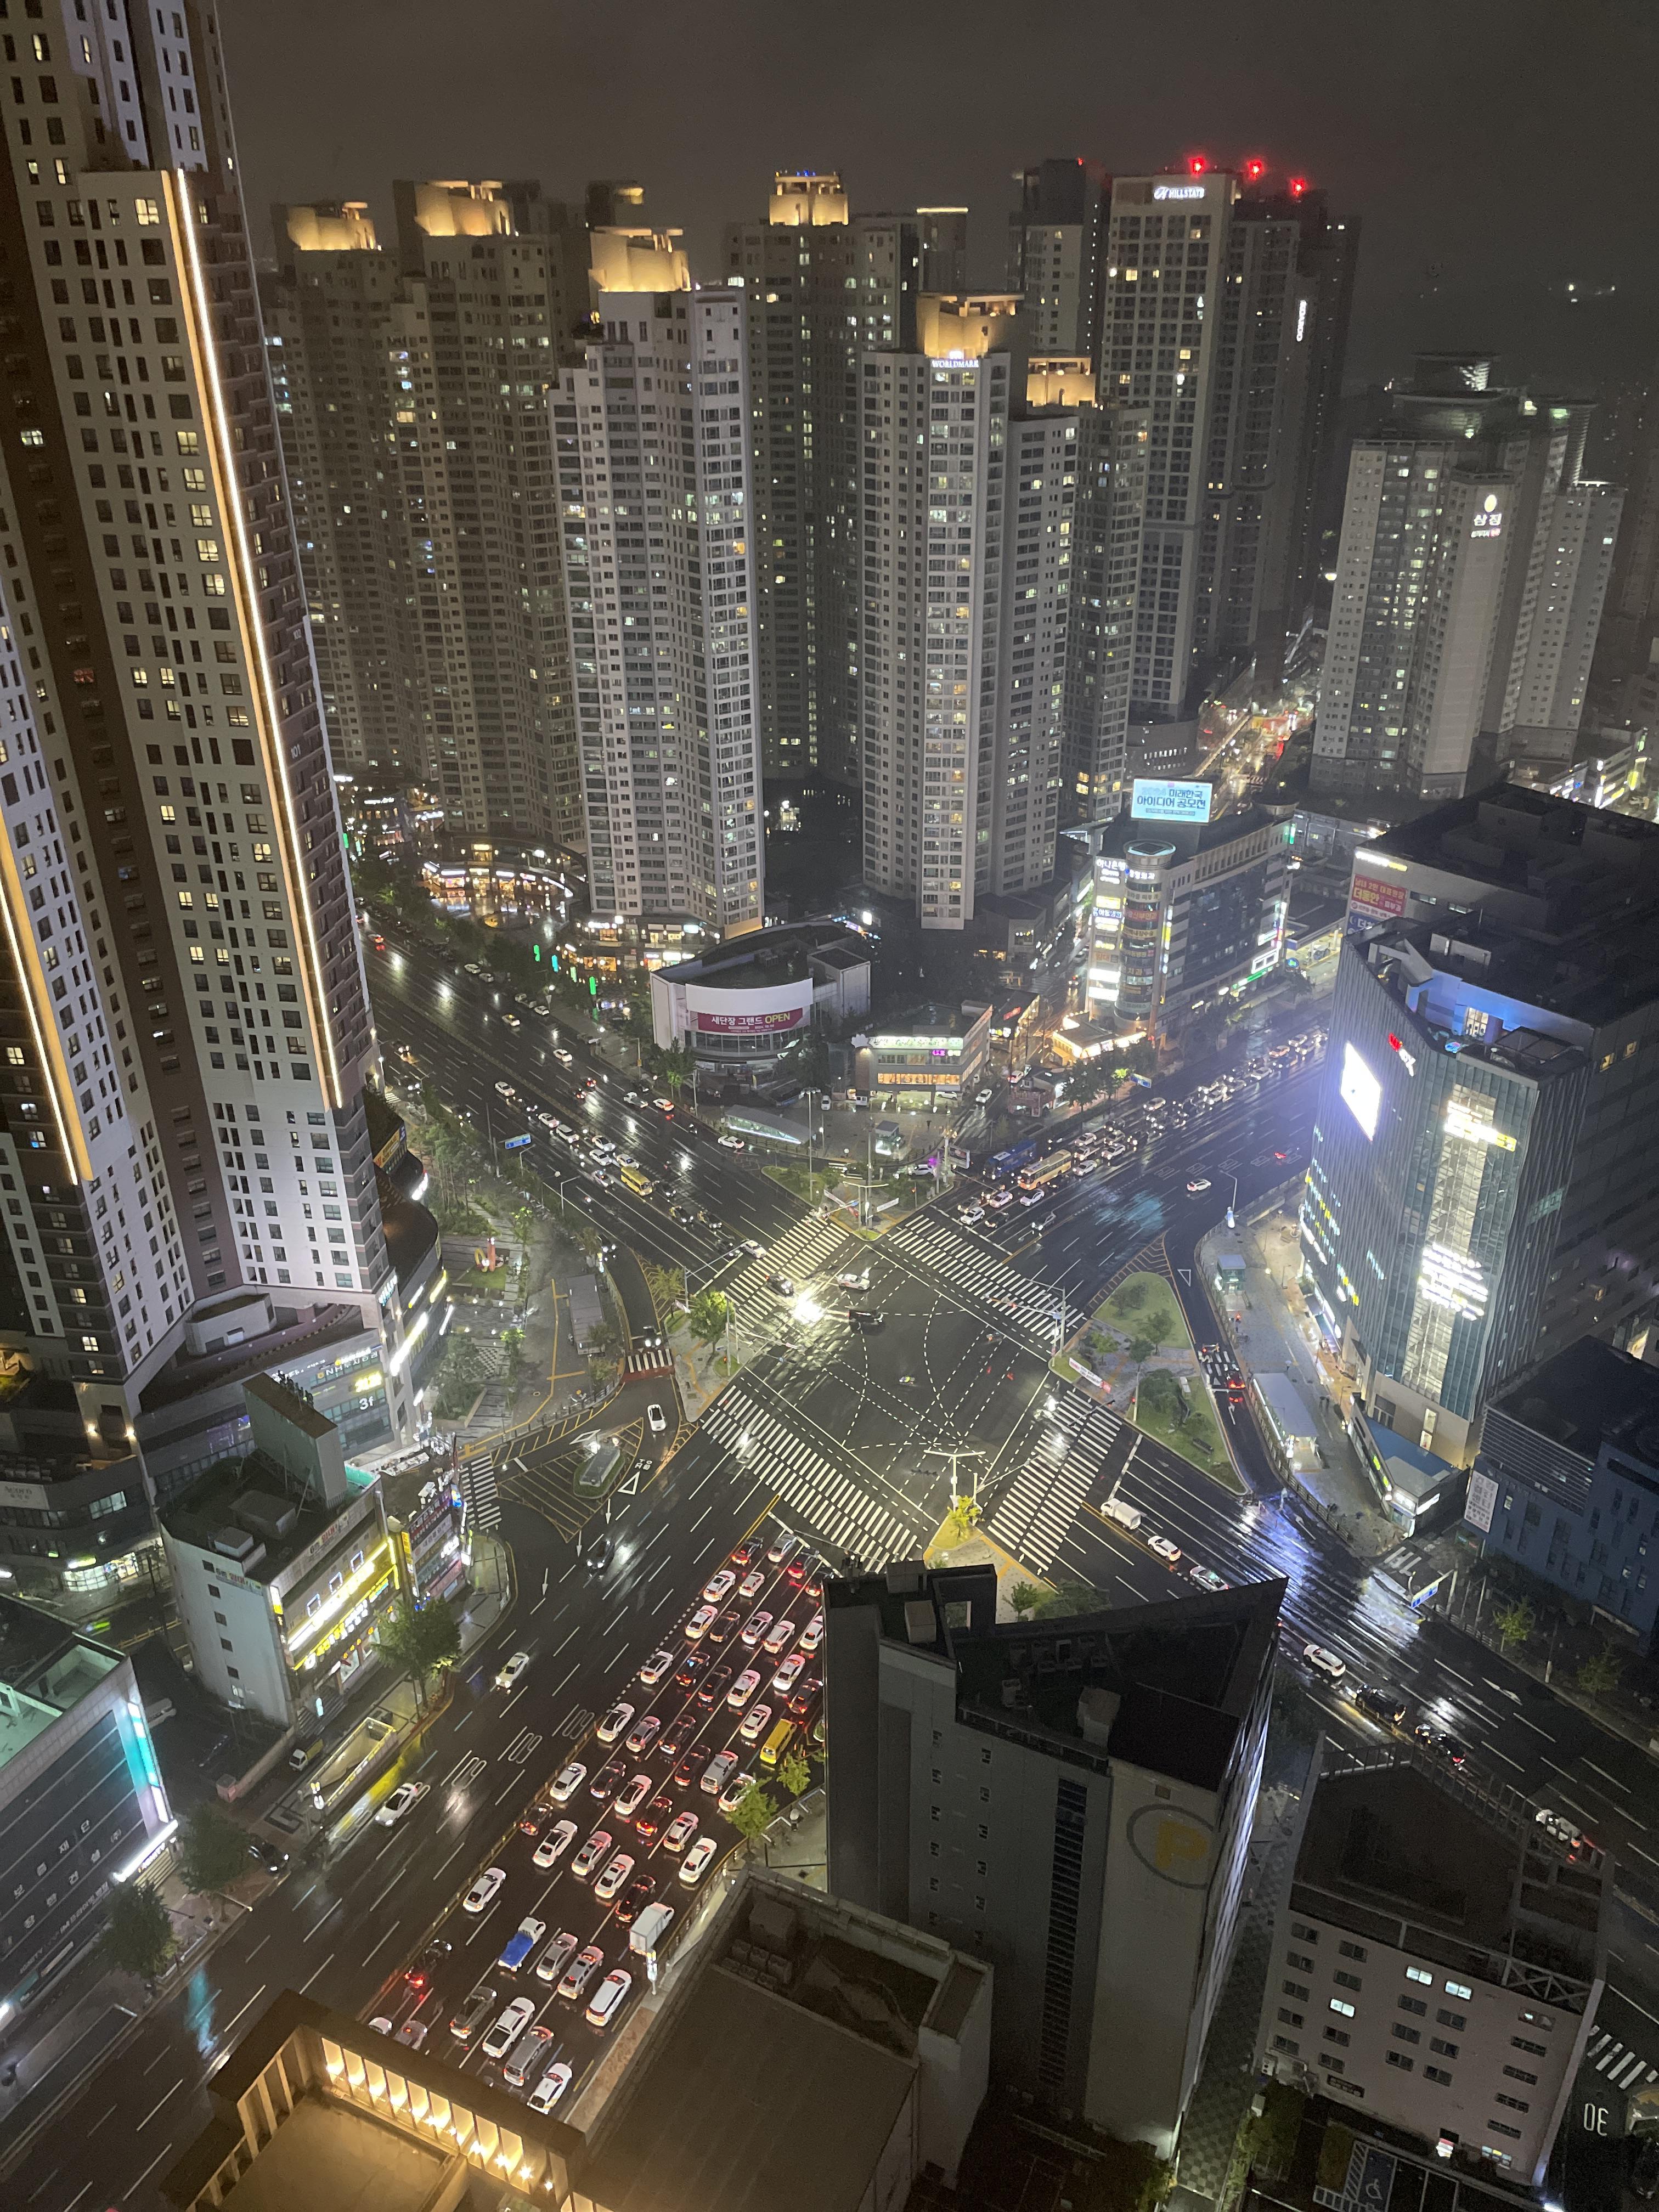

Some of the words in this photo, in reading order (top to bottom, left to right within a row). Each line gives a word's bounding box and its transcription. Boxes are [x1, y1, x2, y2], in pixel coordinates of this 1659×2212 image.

[1169, 789, 1203, 799] 미래한국
[1137, 795, 1175, 808] 아이디어
[1177, 798, 1206, 809] 공모전
[712, 1015, 736, 1026] 새단장
[737, 1016, 763, 1026] 그랜드
[764, 1012, 791, 1024] OPEN
[359, 1395, 374, 1410] 3f
